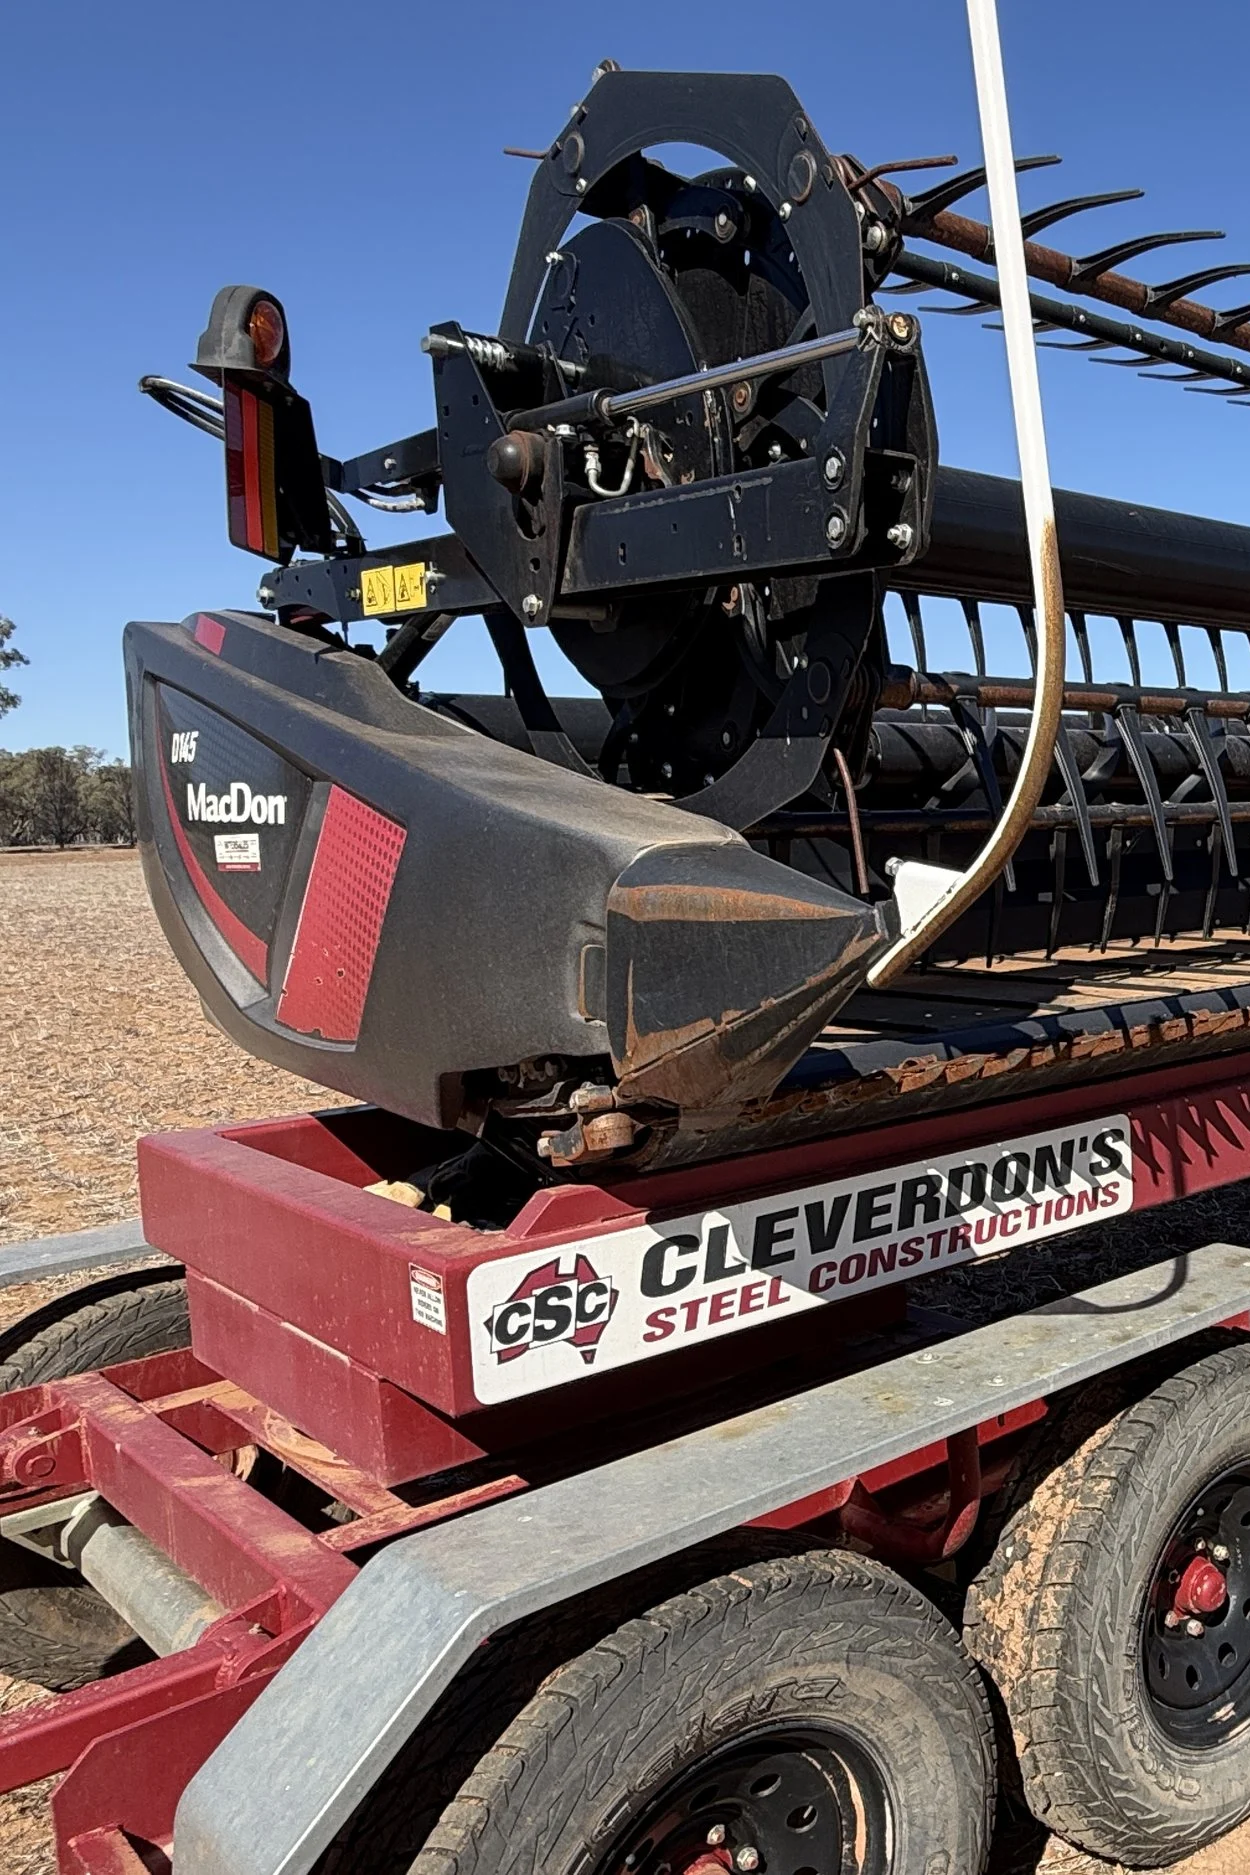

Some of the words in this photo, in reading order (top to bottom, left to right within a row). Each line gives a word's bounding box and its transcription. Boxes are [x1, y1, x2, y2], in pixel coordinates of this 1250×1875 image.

[171, 730, 199, 763] D145
[187, 782, 286, 824] MacDon
[640, 1128, 1125, 1298] CLEVERDON'S
[642, 1275, 791, 1343] STEEL
[808, 1181, 1120, 1293] CONSTRUCTIONS
[494, 1282, 608, 1346] CSC
